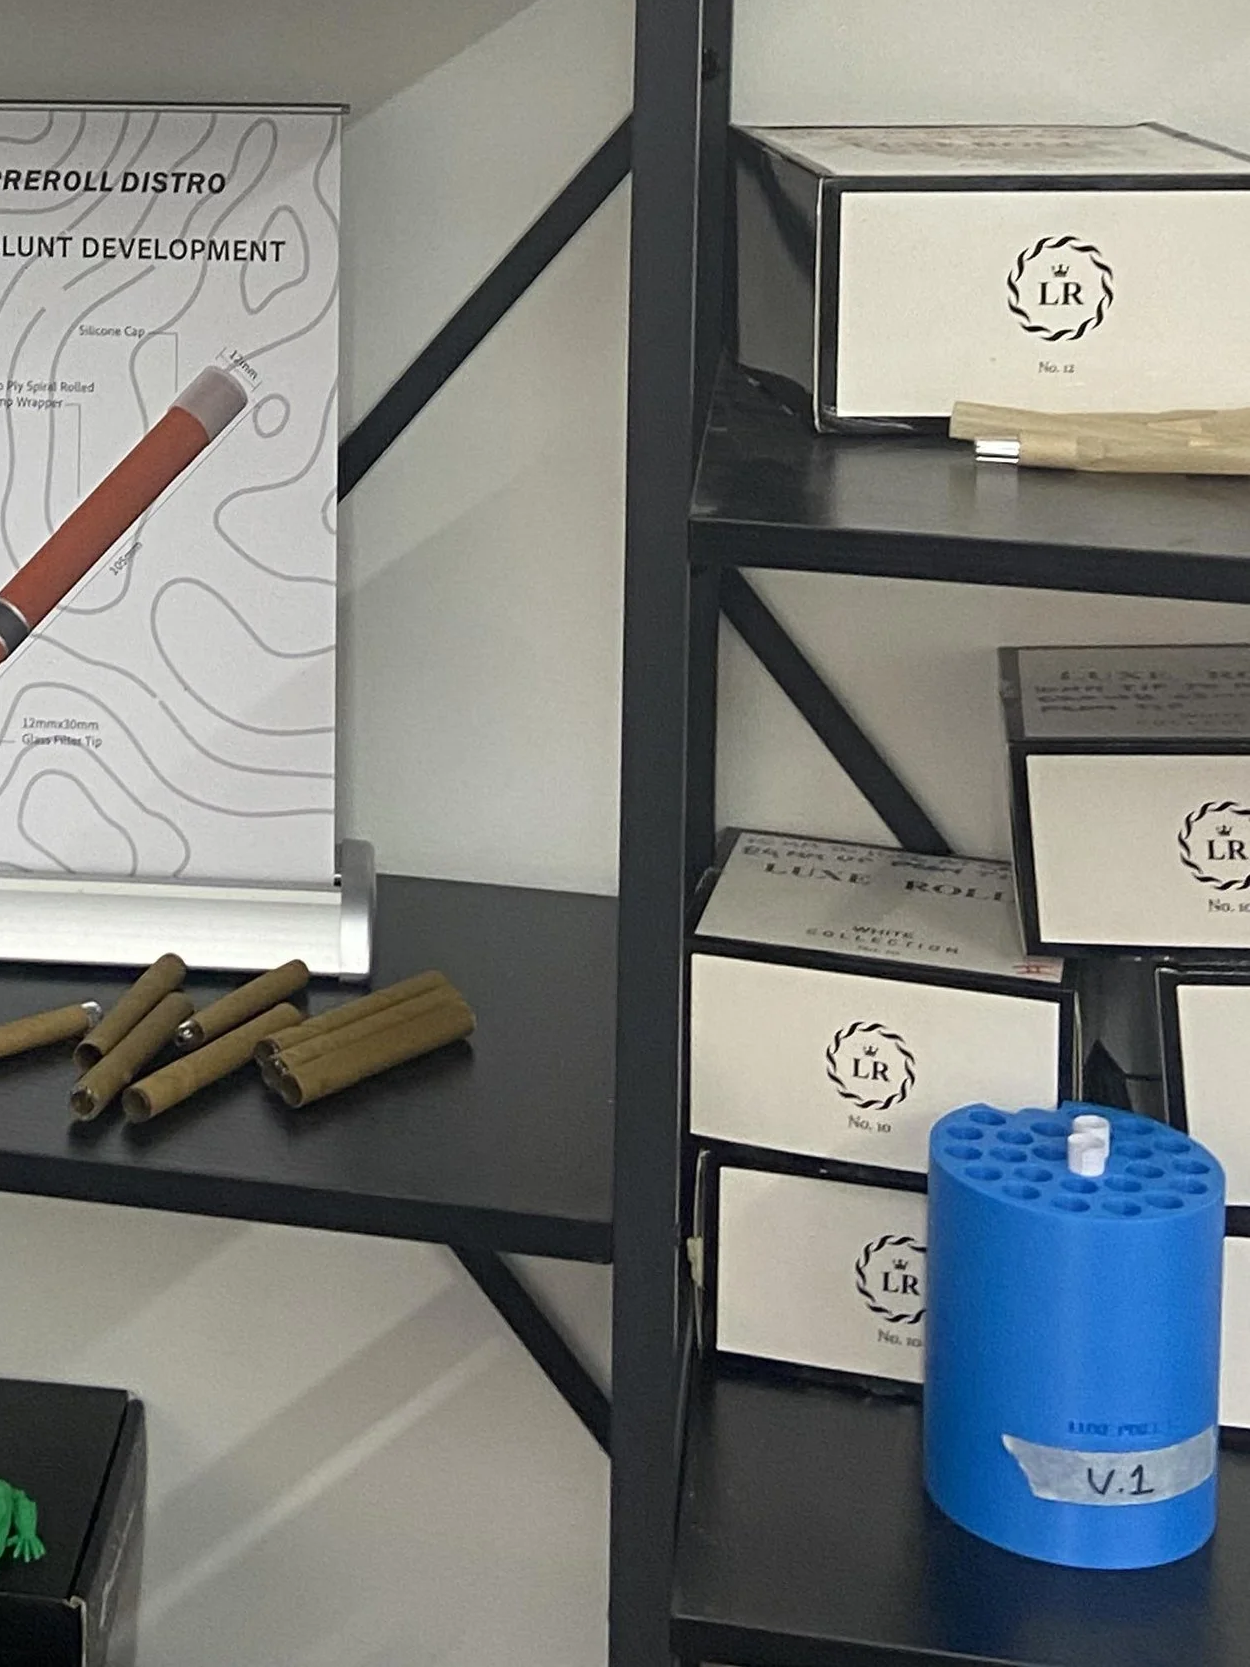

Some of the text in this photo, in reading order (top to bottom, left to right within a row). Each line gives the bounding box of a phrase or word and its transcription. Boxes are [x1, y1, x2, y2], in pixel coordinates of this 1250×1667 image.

[82, 237, 286, 263] DEVELOPMENT
[1038, 281, 1084, 305] LR
[79, 324, 146, 340] Silicone Cap
[1038, 361, 1060, 374] No.
[6, 381, 24, 394] Ply
[26, 381, 57, 395] Spiral
[60, 382, 95, 393] Rolled
[16, 398, 63, 410] Wrapper
[21, 733, 103, 749] Glass Filter Tip
[1207, 839, 1249, 861] LR
[764, 862, 871, 885] LUXE
[1208, 898, 1235, 913] No.
[853, 1058, 890, 1082] LR
[848, 1114, 872, 1131] No.
[882, 1271, 921, 1296] LR
[877, 1329, 902, 1346] No.
[1087, 1463, 1155, 1496] V.1
